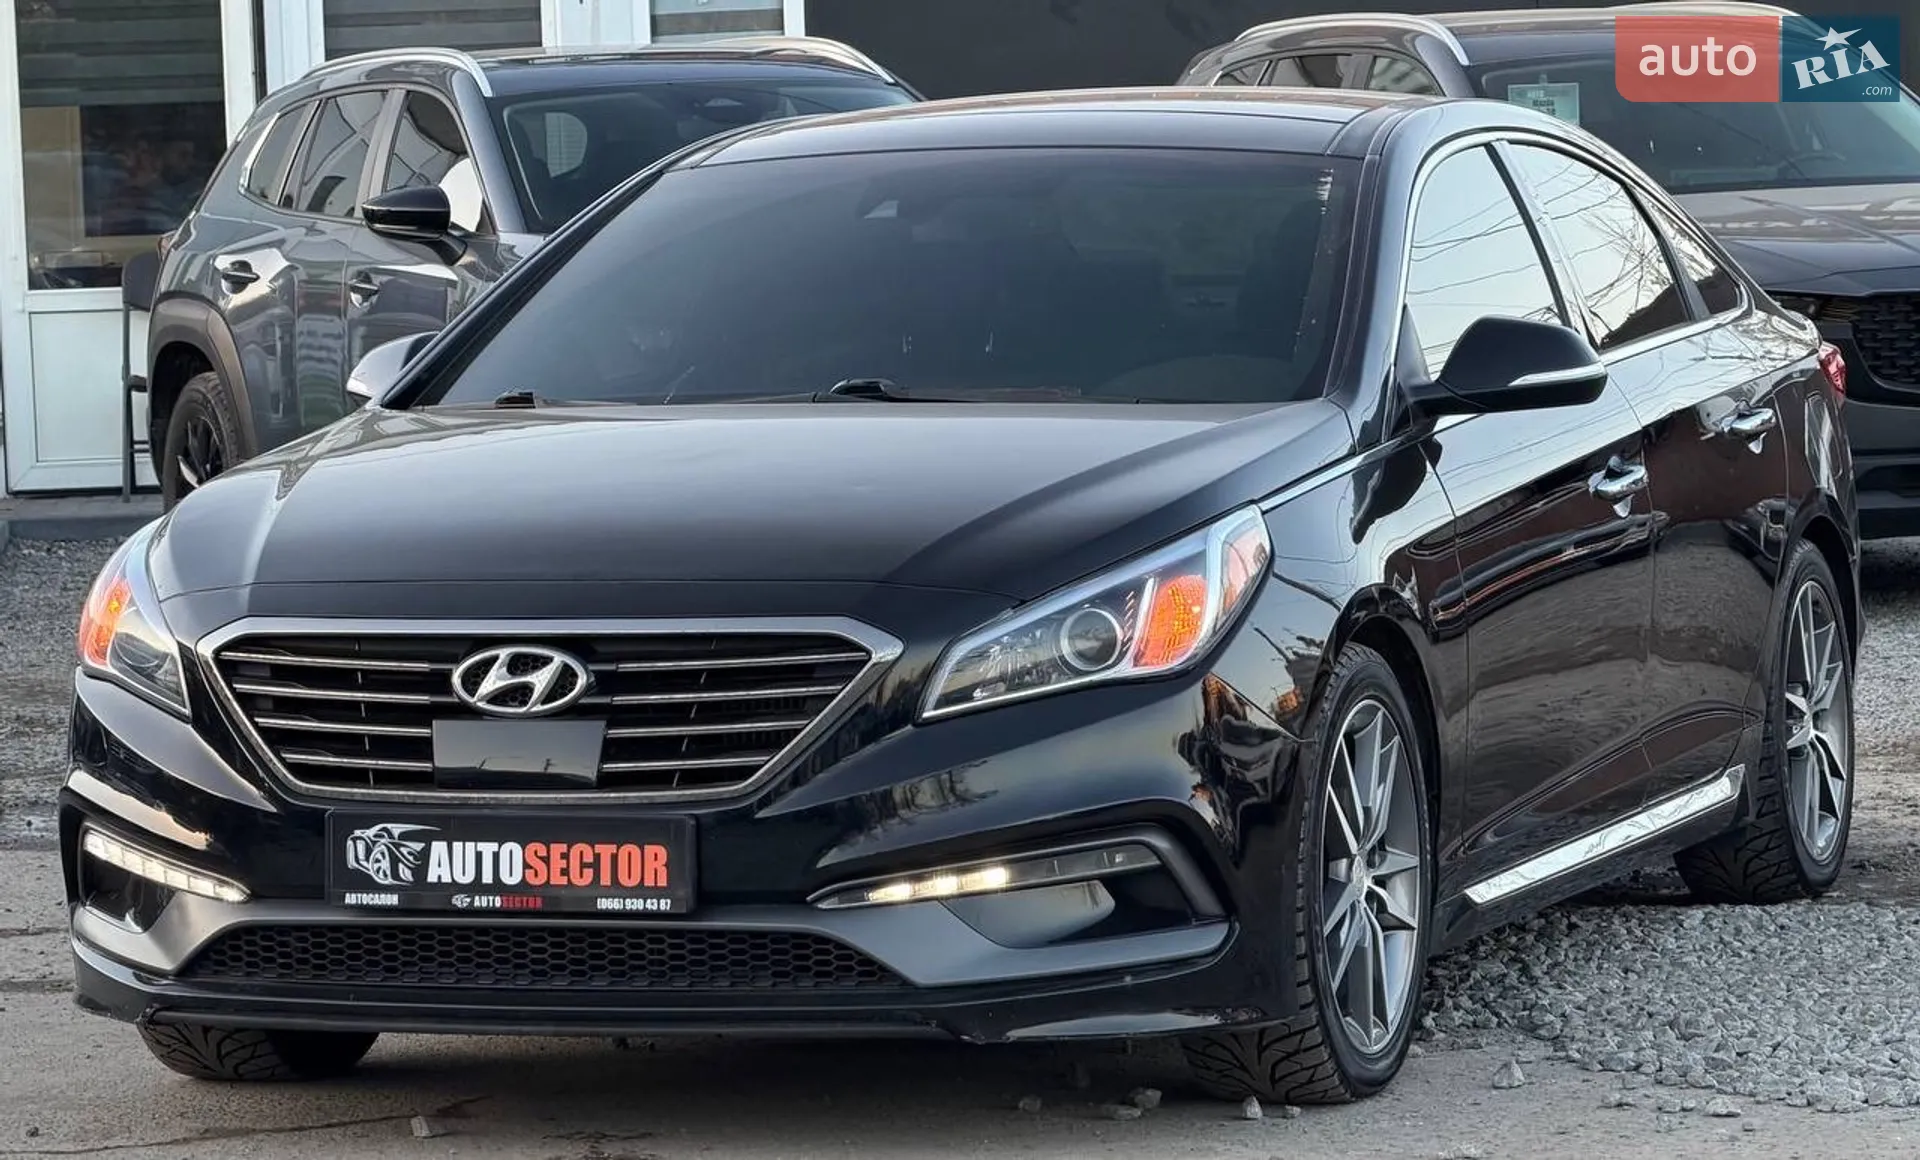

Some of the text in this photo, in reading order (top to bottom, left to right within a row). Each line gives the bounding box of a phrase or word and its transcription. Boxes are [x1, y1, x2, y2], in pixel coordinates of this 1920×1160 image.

[427, 841, 668, 887] AUTOSECTOR
[625, 898, 644, 910] 930
[645, 899, 658, 911] 43
[659, 899, 671, 911] 87
